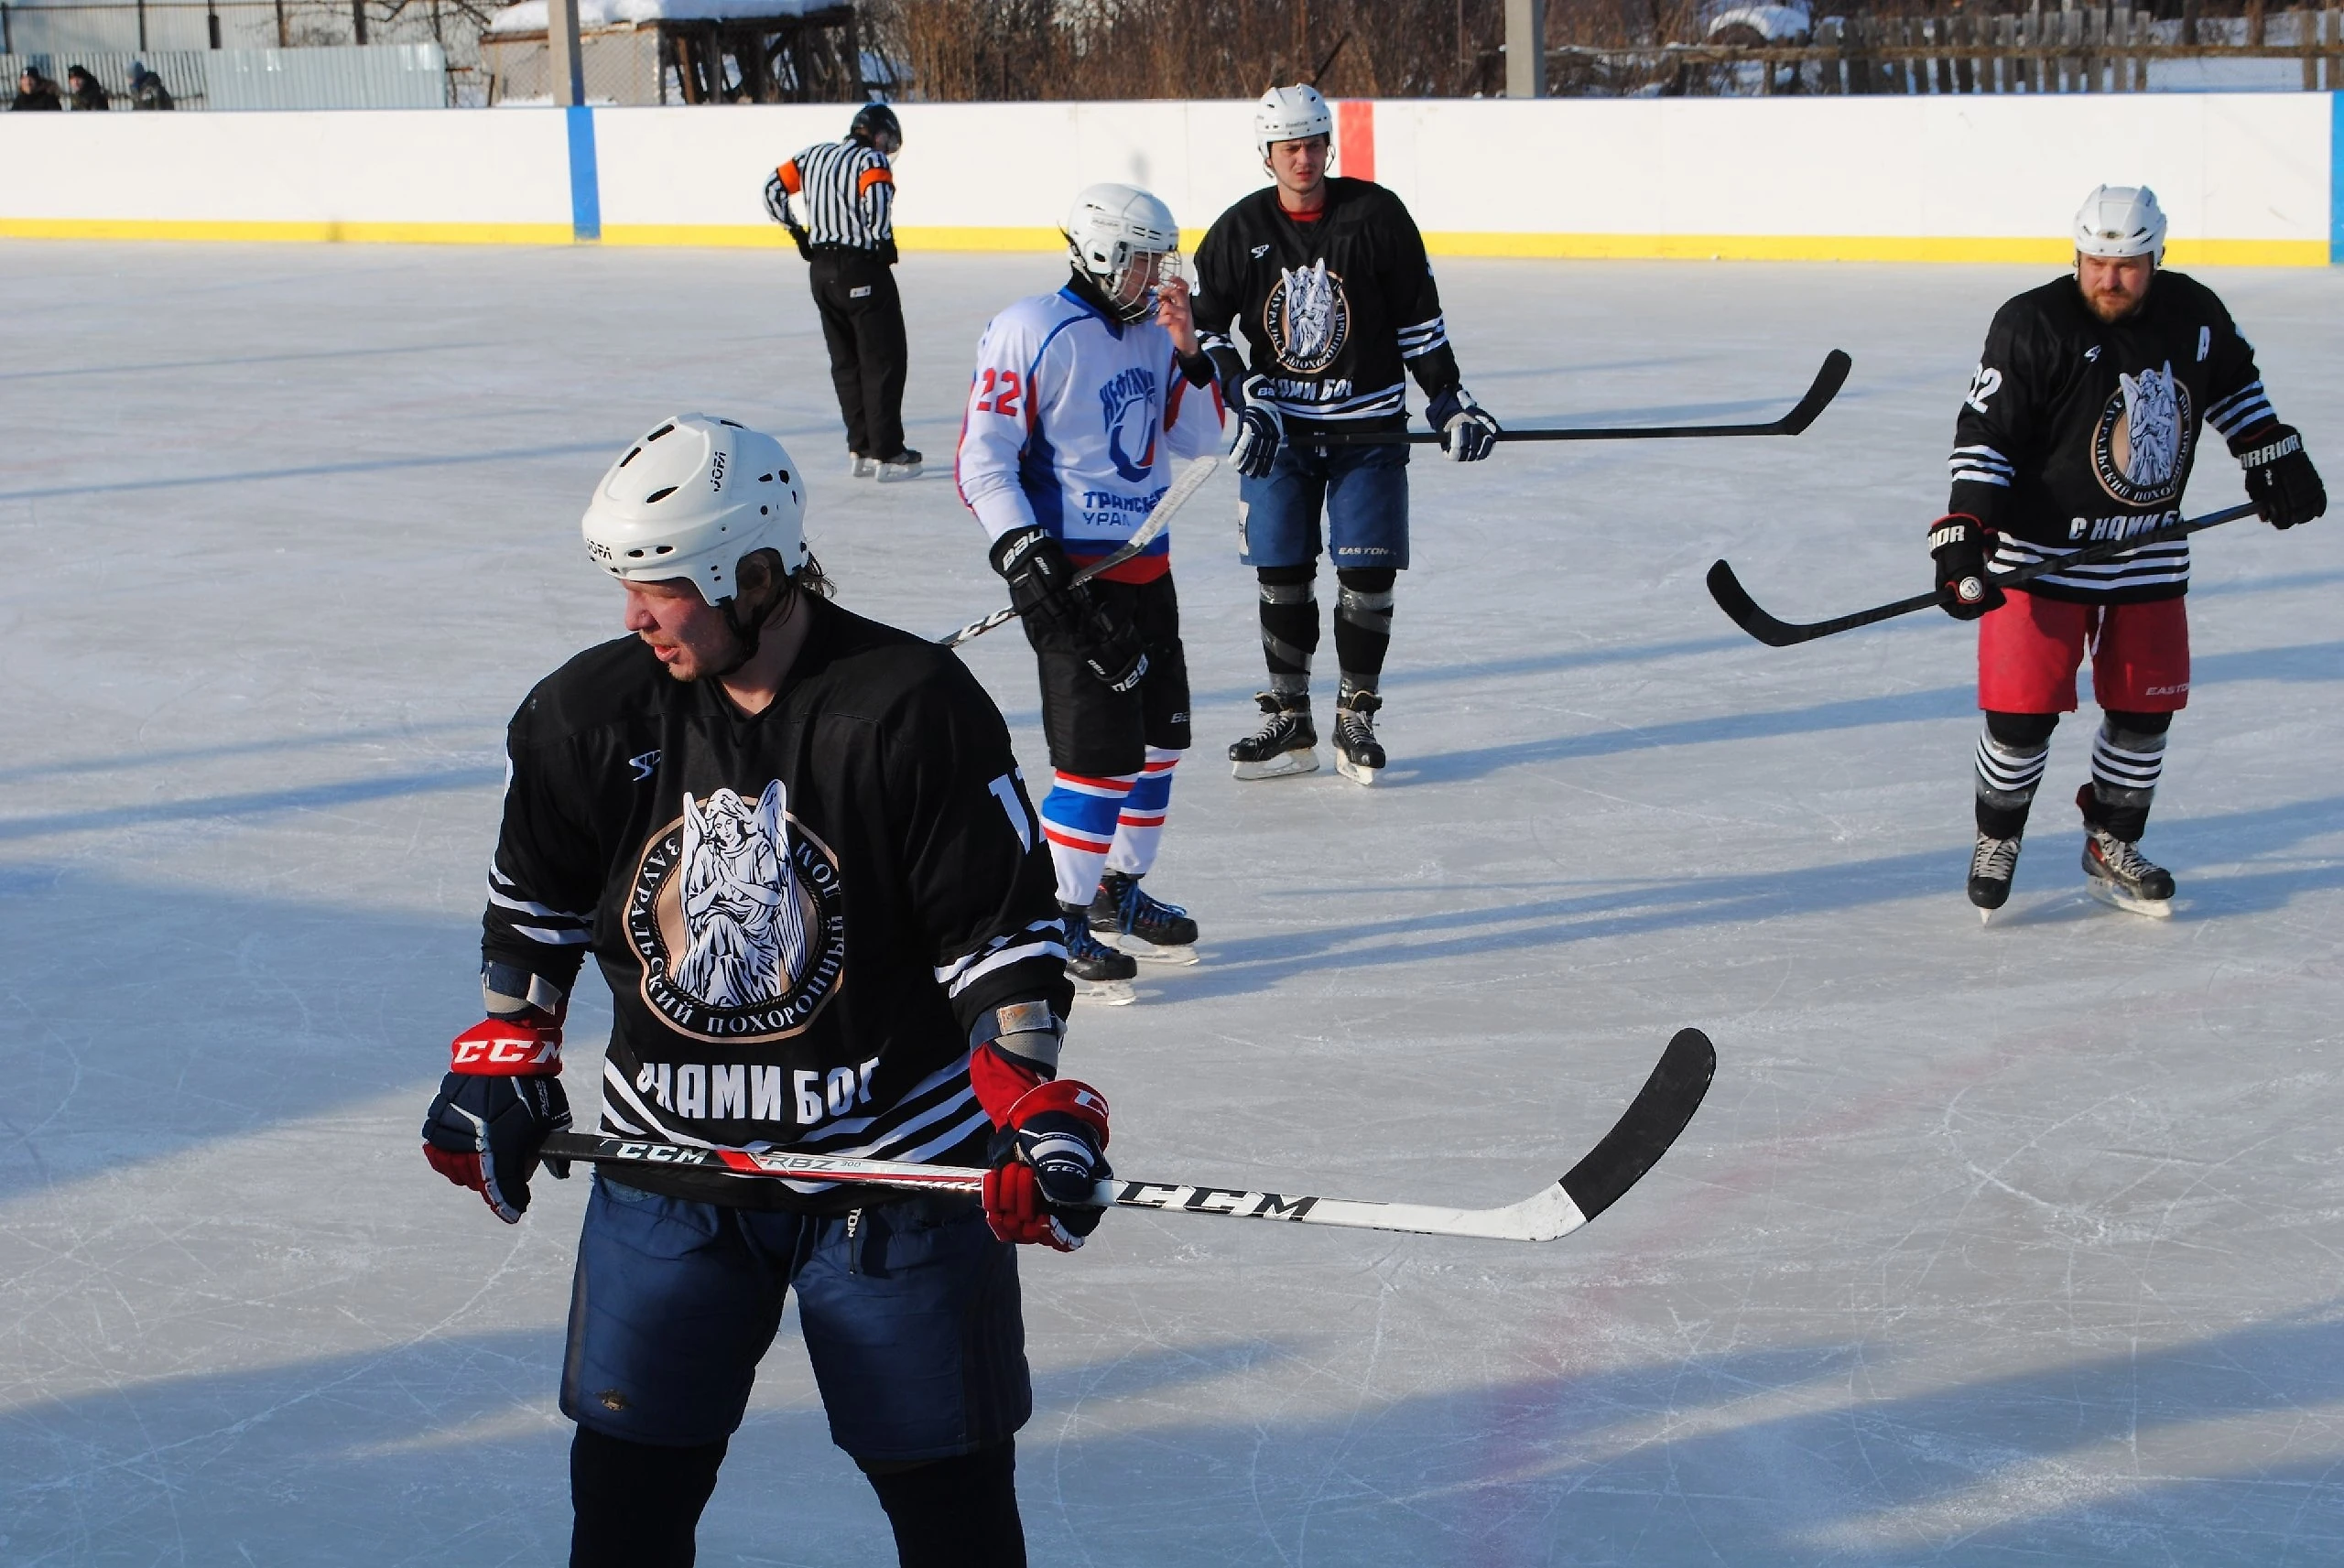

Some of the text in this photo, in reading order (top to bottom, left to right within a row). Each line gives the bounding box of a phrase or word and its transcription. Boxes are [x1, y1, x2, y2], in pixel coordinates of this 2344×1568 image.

[976, 367, 1022, 417] 22
[2239, 434, 2301, 470] ARRIOR
[710, 451, 727, 492] JOFA
[586, 537, 613, 560] JOFA
[1338, 547, 1390, 556] EASTON
[2145, 683, 2190, 696] EASTO
[630, 836, 695, 1025] ЗАУРАЛЬСКИЙ
[706, 914, 845, 1033] ПОХОРОННЫЙ
[616, 1142, 706, 1165] CCM
[766, 1154, 836, 1172] RBZ
[1115, 1181, 1322, 1222] CCM
